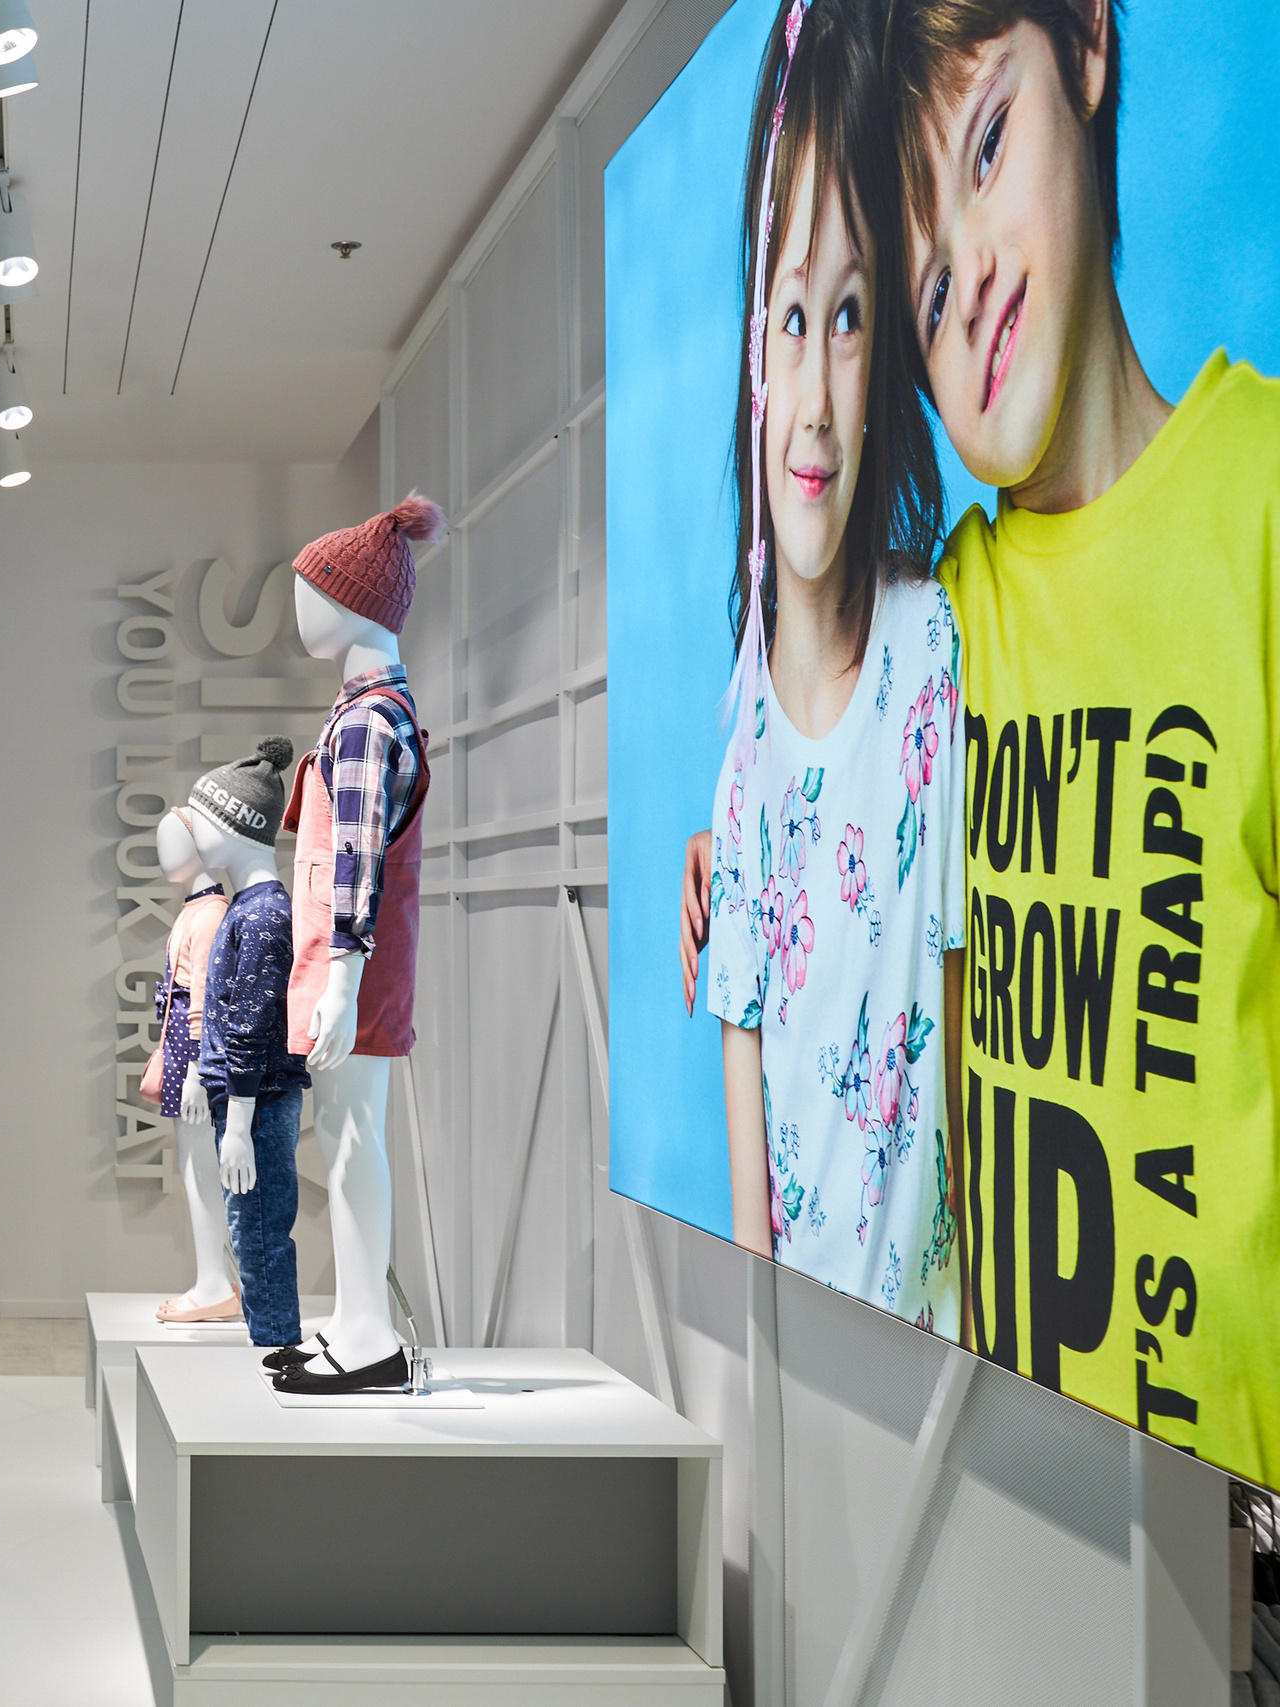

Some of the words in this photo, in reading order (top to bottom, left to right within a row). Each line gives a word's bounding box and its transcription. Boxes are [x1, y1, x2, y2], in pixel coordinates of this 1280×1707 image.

[116, 569, 174, 714] YOU
[115, 744, 174, 934] LOOK
[195, 776, 268, 830] LEGEND
[964, 704, 1132, 879] DON'T
[969, 886, 1122, 1087] GROW
[1134, 704, 1218, 1093] TRAP!)
[967, 1065, 1114, 1394] UP
[1134, 1144, 1198, 1218] A
[1134, 1254, 1198, 1457] T'S
